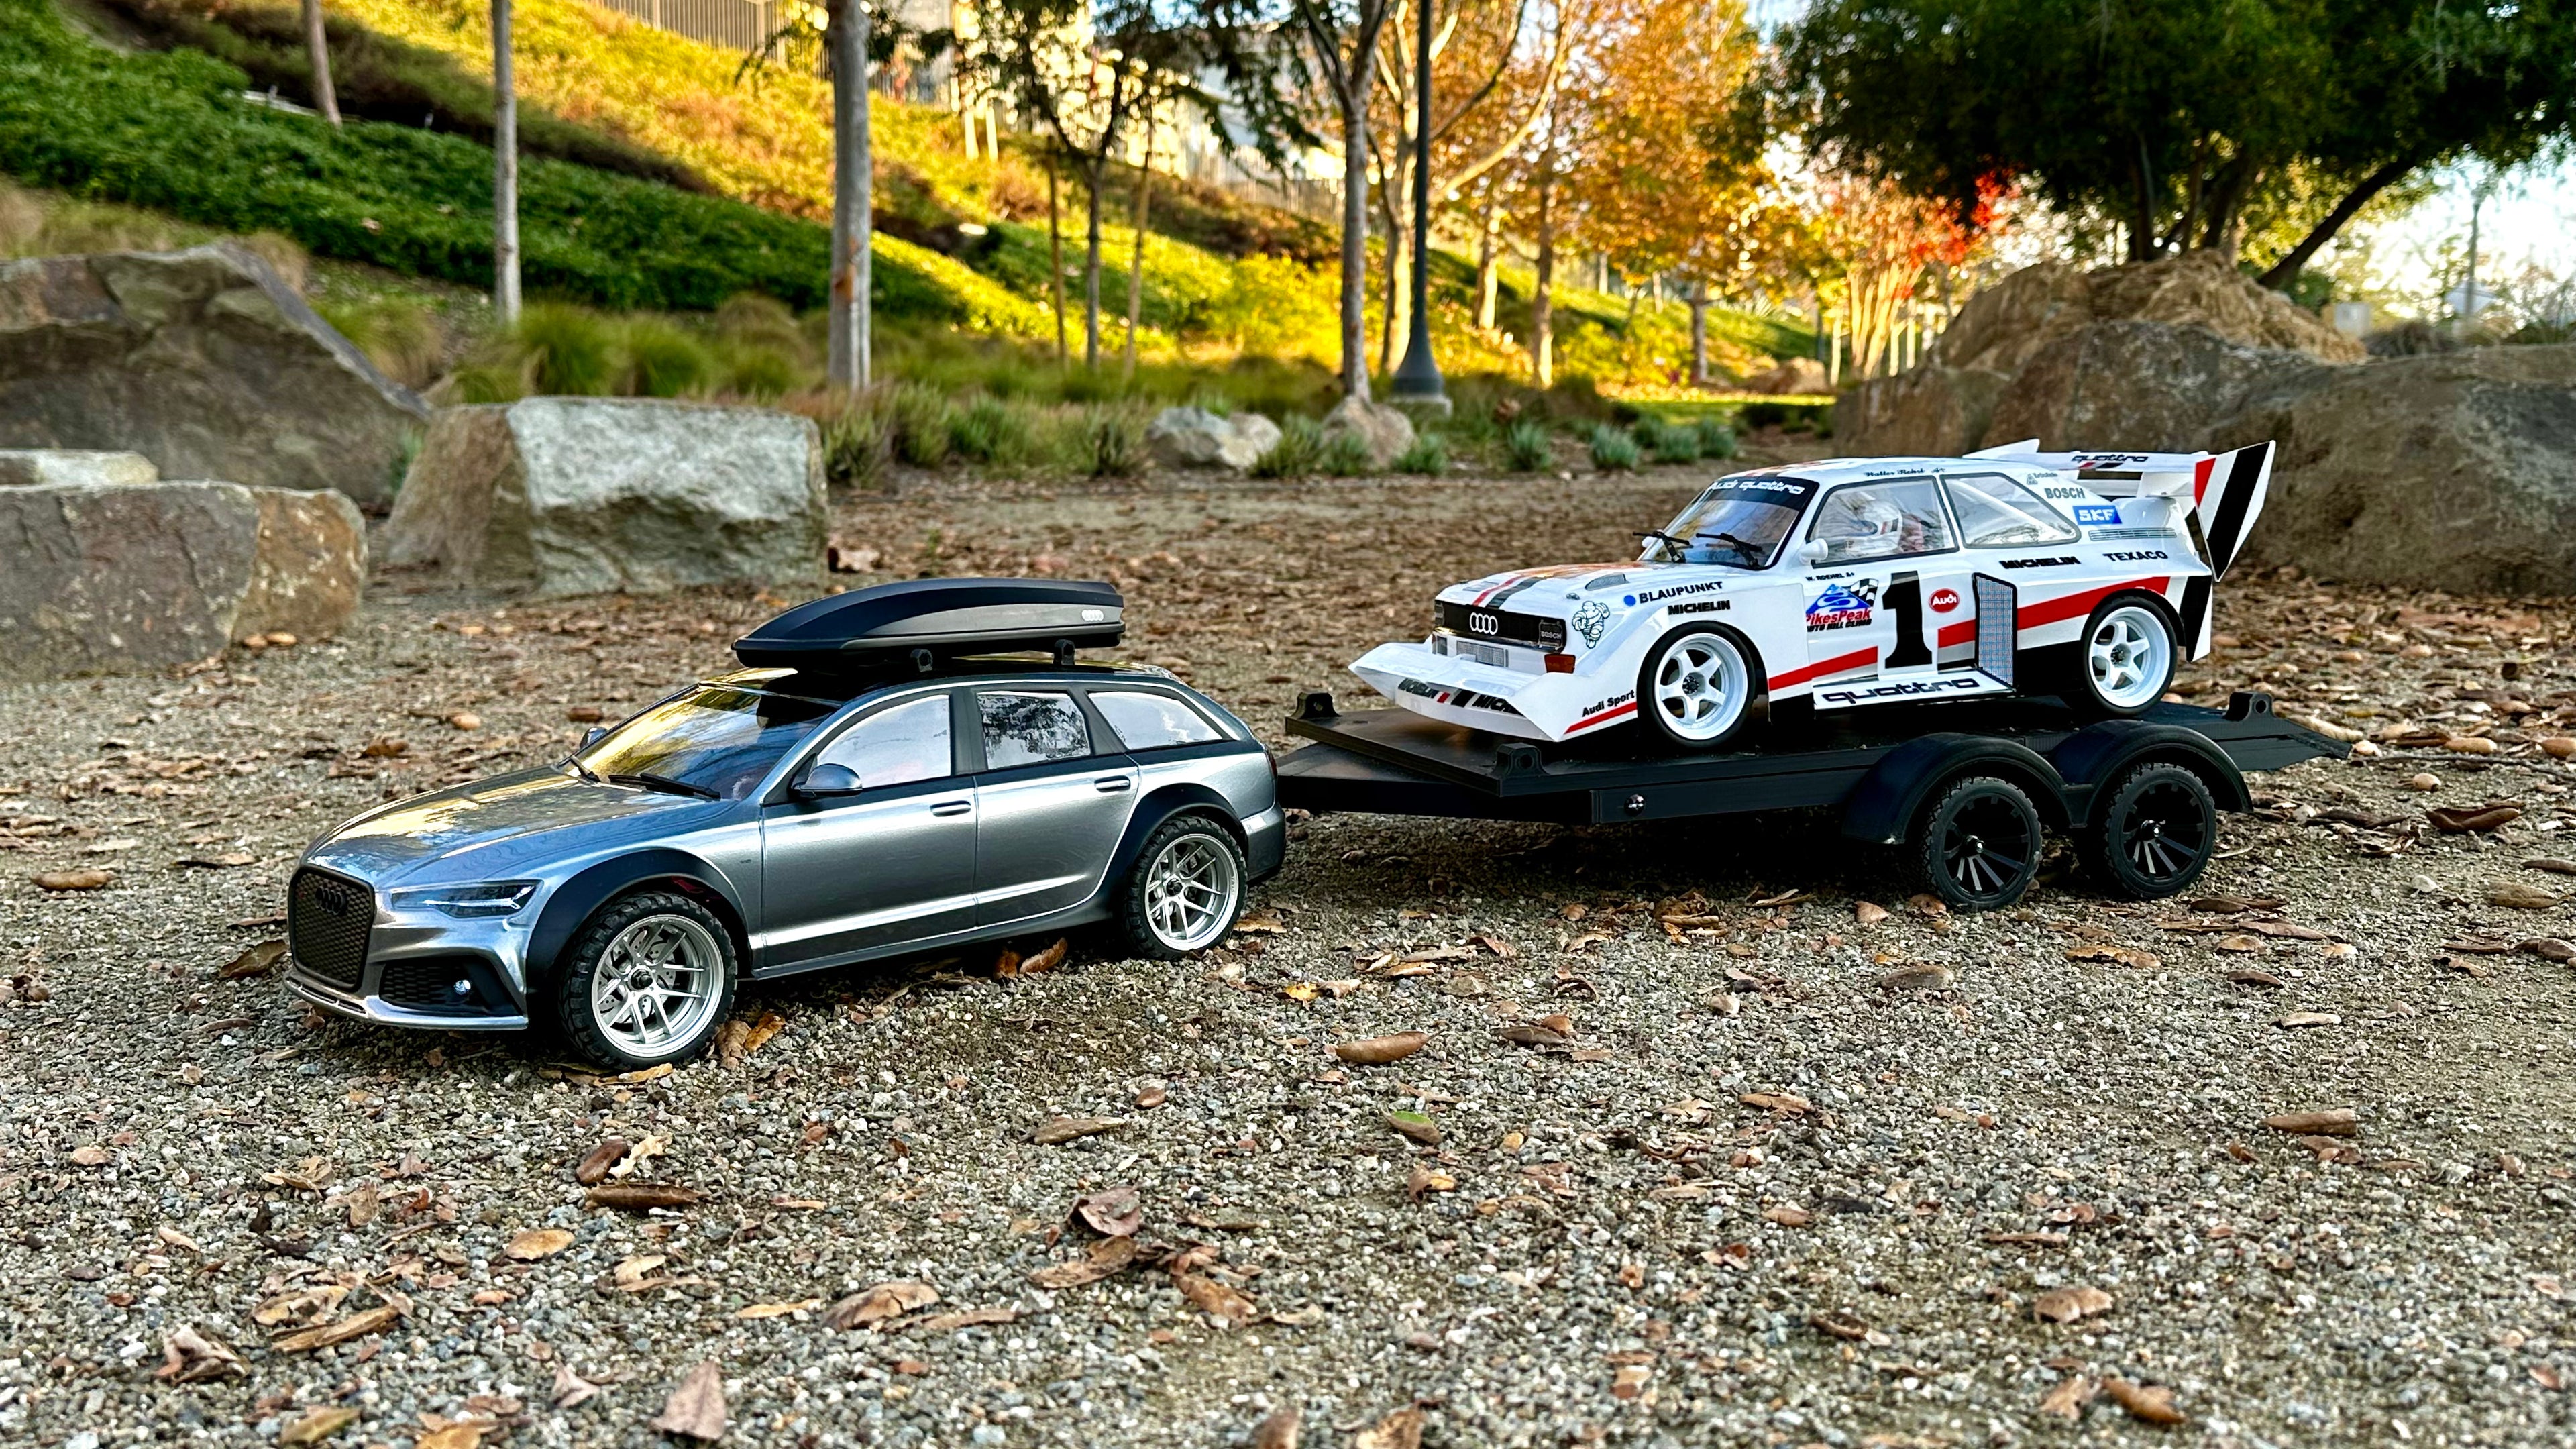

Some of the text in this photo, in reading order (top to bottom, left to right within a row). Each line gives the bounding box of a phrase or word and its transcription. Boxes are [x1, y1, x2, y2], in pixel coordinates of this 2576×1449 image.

[2071, 454, 2149, 463] quattro
[1711, 479, 1805, 495] Audi quattro
[2044, 488, 2086, 499] BOSCH
[2078, 509, 2113, 521] SKF
[1999, 556, 2082, 569] MICHELIN
[2102, 550, 2169, 562] TEXACO
[1639, 581, 1723, 604] BLAUPUNKT
[1932, 594, 1957, 606] Audi
[1668, 600, 1730, 615] MICHELIN
[1882, 570, 1932, 669] 1
[1807, 624, 1825, 632] UTO
[1821, 678, 1980, 704] quattro
[1582, 689, 1635, 717] Audi Sport
